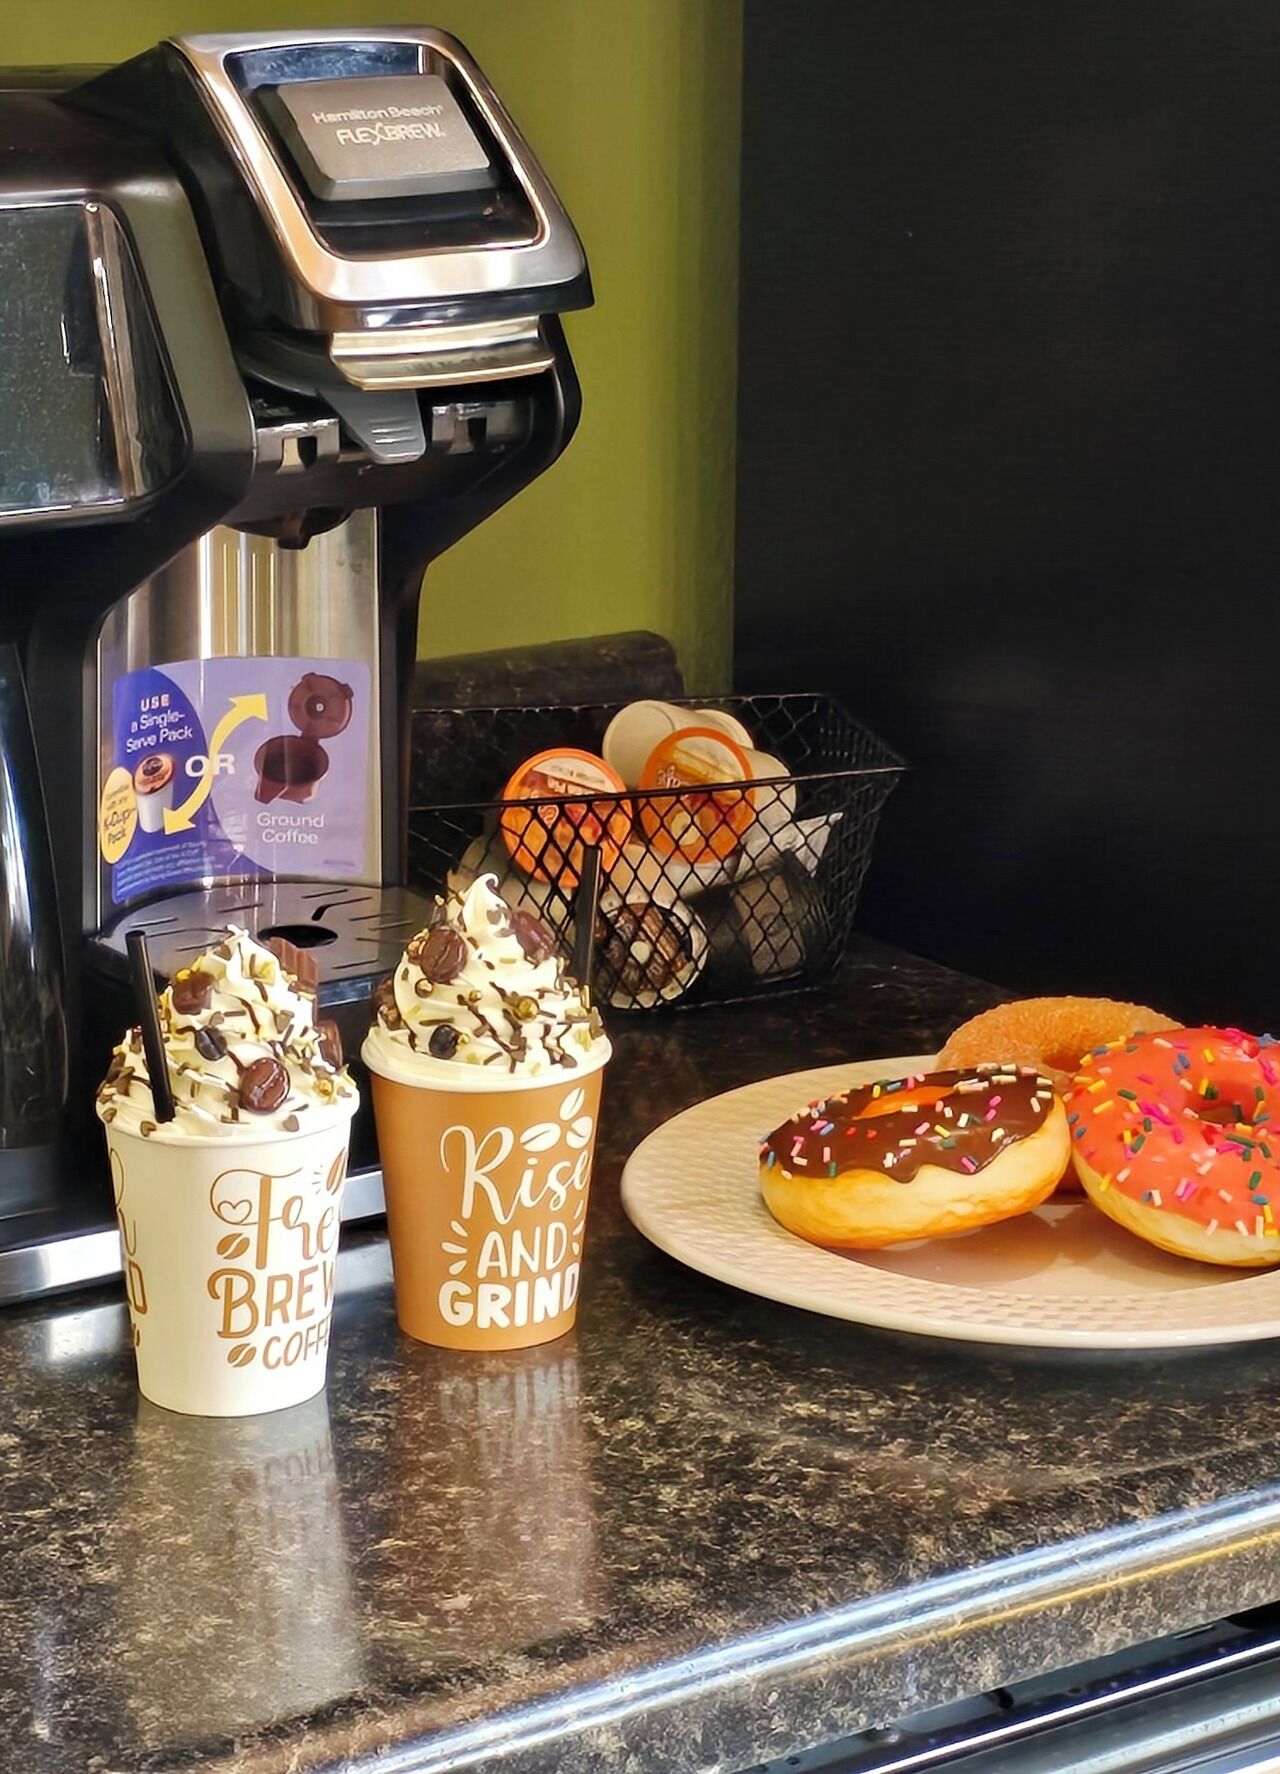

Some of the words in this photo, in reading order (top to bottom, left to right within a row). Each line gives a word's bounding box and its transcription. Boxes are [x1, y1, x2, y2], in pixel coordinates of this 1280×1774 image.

[312, 109, 389, 124] Hamilton
[140, 694, 170, 712] USE
[140, 709, 186, 730] Single-
[126, 735, 157, 753] Serve
[160, 726, 193, 743] Pack
[185, 754, 236, 778] OR
[256, 812, 325, 828] Ground
[262, 829, 319, 845] Coffee
[440, 1125, 589, 1226] Rise
[477, 1222, 568, 1279] AND
[439, 1262, 580, 1329] GRIND
